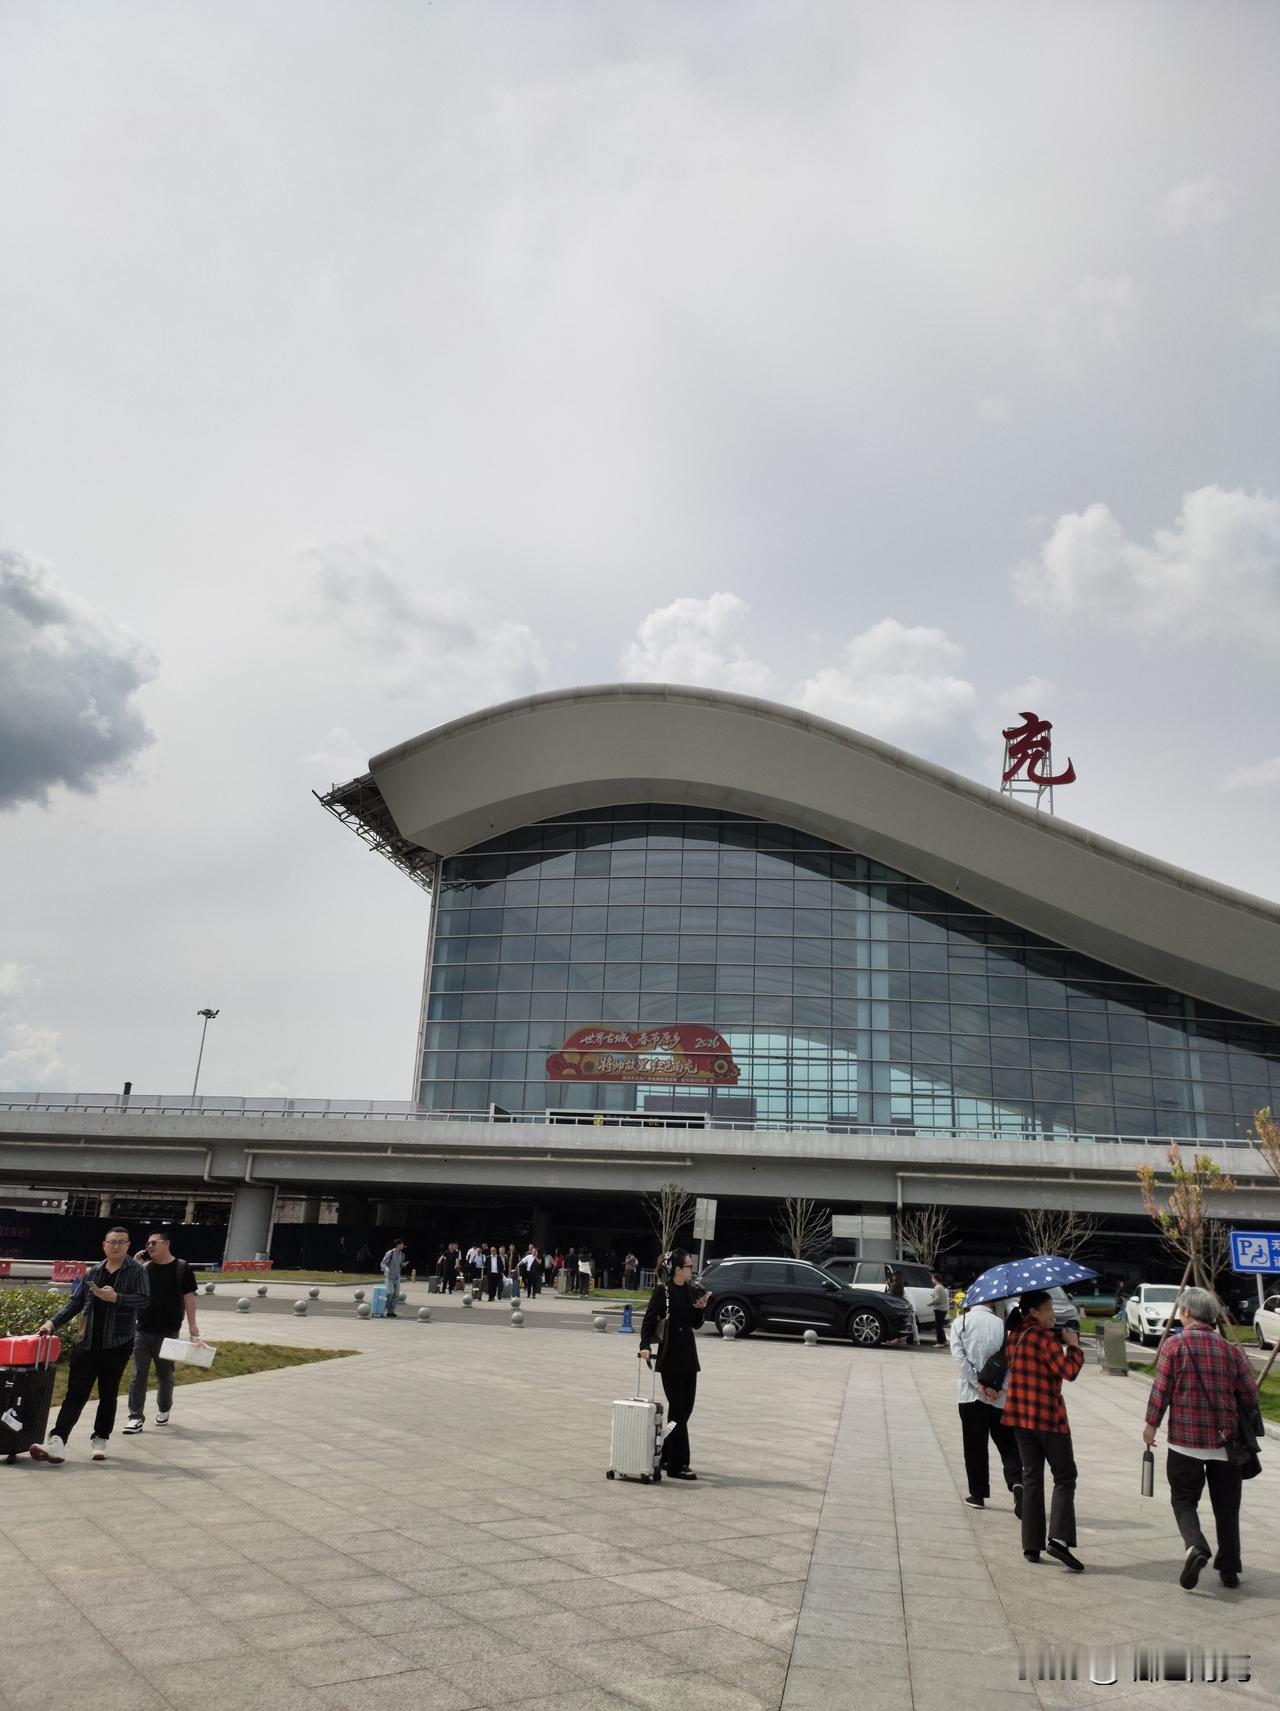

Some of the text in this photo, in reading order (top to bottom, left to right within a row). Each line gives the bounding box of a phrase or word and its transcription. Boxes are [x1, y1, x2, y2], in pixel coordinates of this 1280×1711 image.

[1002, 712, 1076, 785] 充
[580, 1031, 720, 1051] 世界古城 春节原乡 2026
[1239, 1240, 1252, 1255] P
